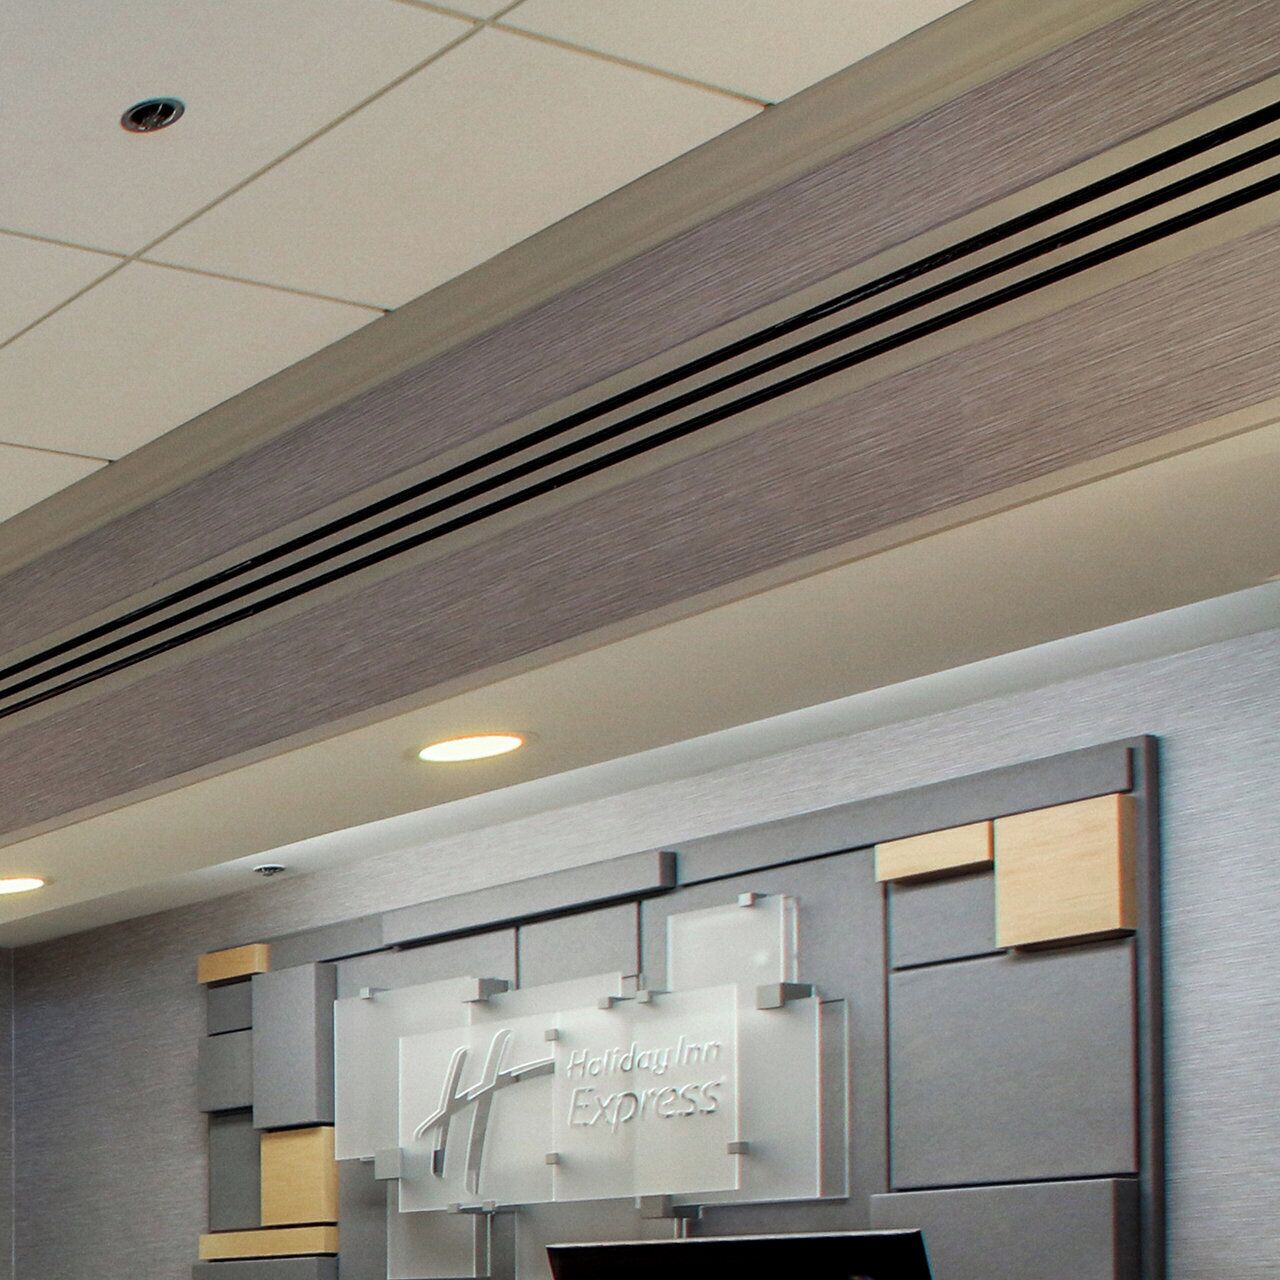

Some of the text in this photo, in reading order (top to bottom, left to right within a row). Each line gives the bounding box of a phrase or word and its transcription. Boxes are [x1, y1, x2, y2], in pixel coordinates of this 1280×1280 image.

[566, 1034, 721, 1076] Holiday Inn
[567, 1080, 722, 1135] Express
